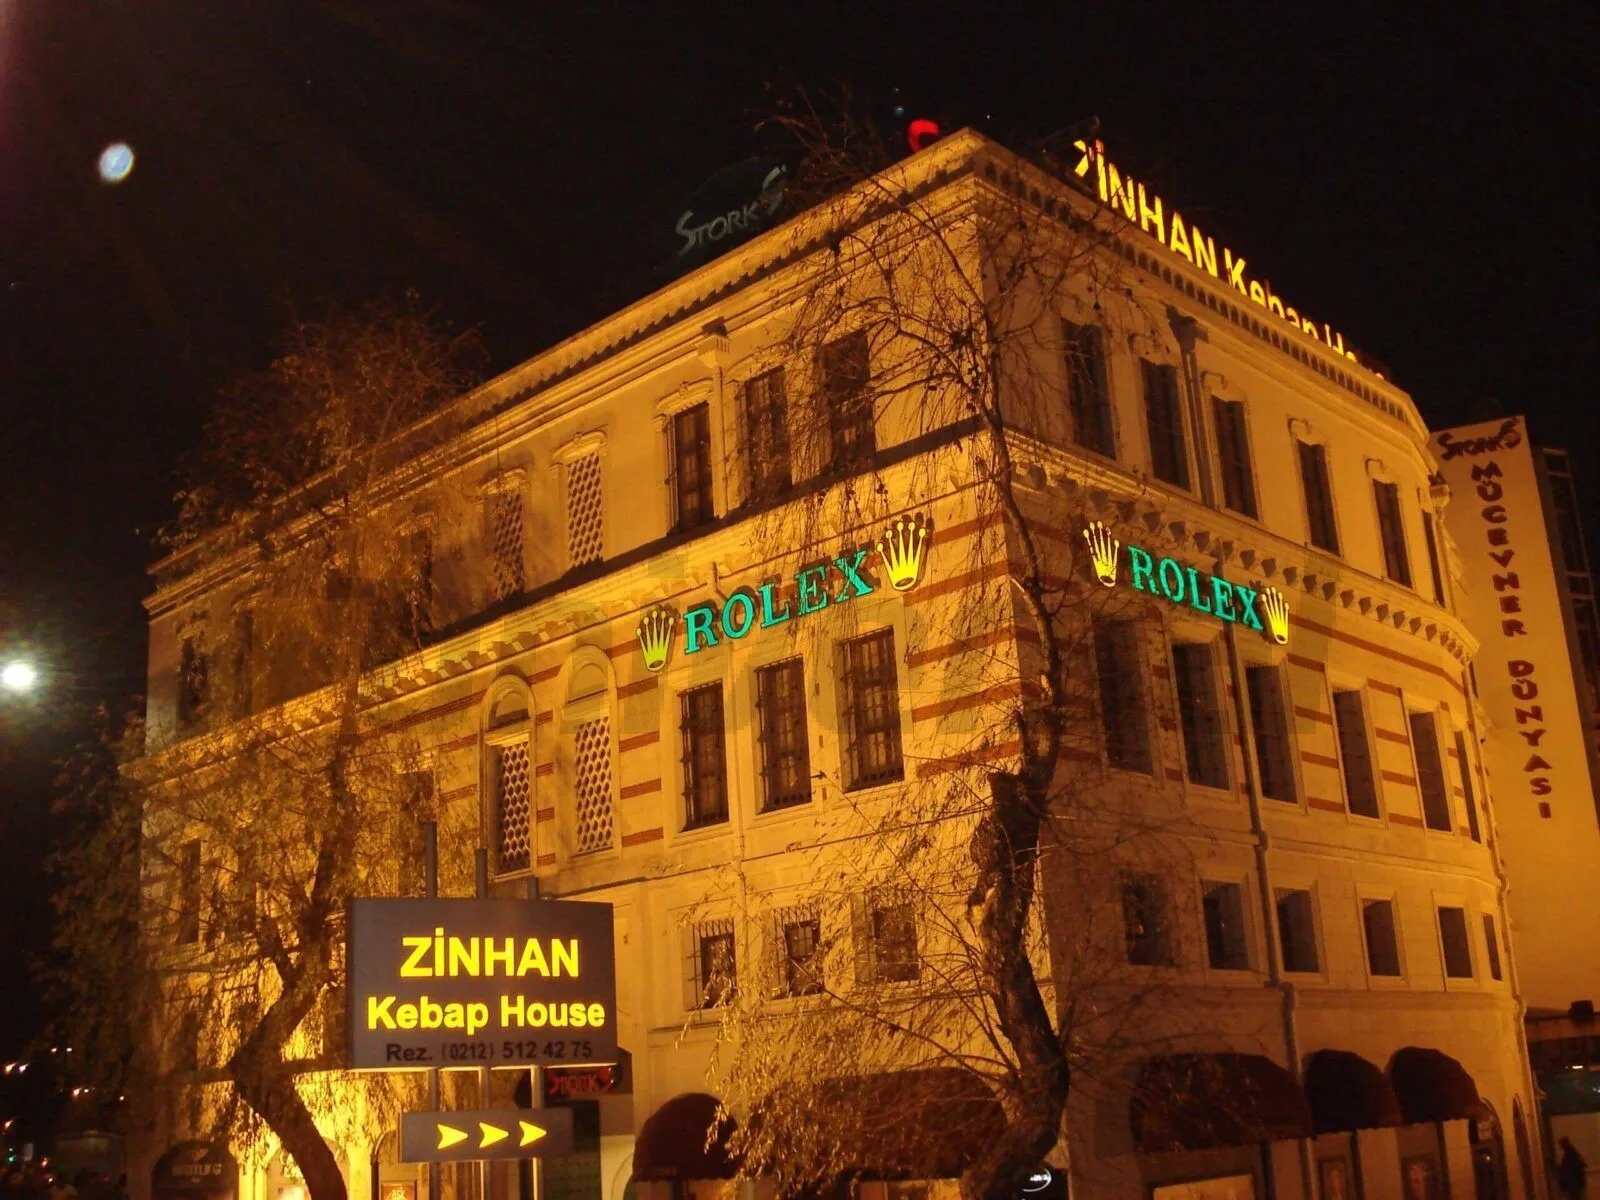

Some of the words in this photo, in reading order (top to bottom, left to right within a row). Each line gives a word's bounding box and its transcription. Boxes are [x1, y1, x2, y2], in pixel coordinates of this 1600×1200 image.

[684, 550, 875, 656] ROLEX
[1127, 544, 1264, 632] ROLEX
[400, 927, 580, 978] ZİNHAN
[367, 995, 489, 1036] Kebap
[500, 995, 606, 1028] House
[386, 1043, 433, 1062] Rez.
[442, 1042, 495, 1061] (0212)
[503, 1040, 537, 1059] 512
[543, 1041, 565, 1059] 42
[571, 1040, 593, 1058] 75
